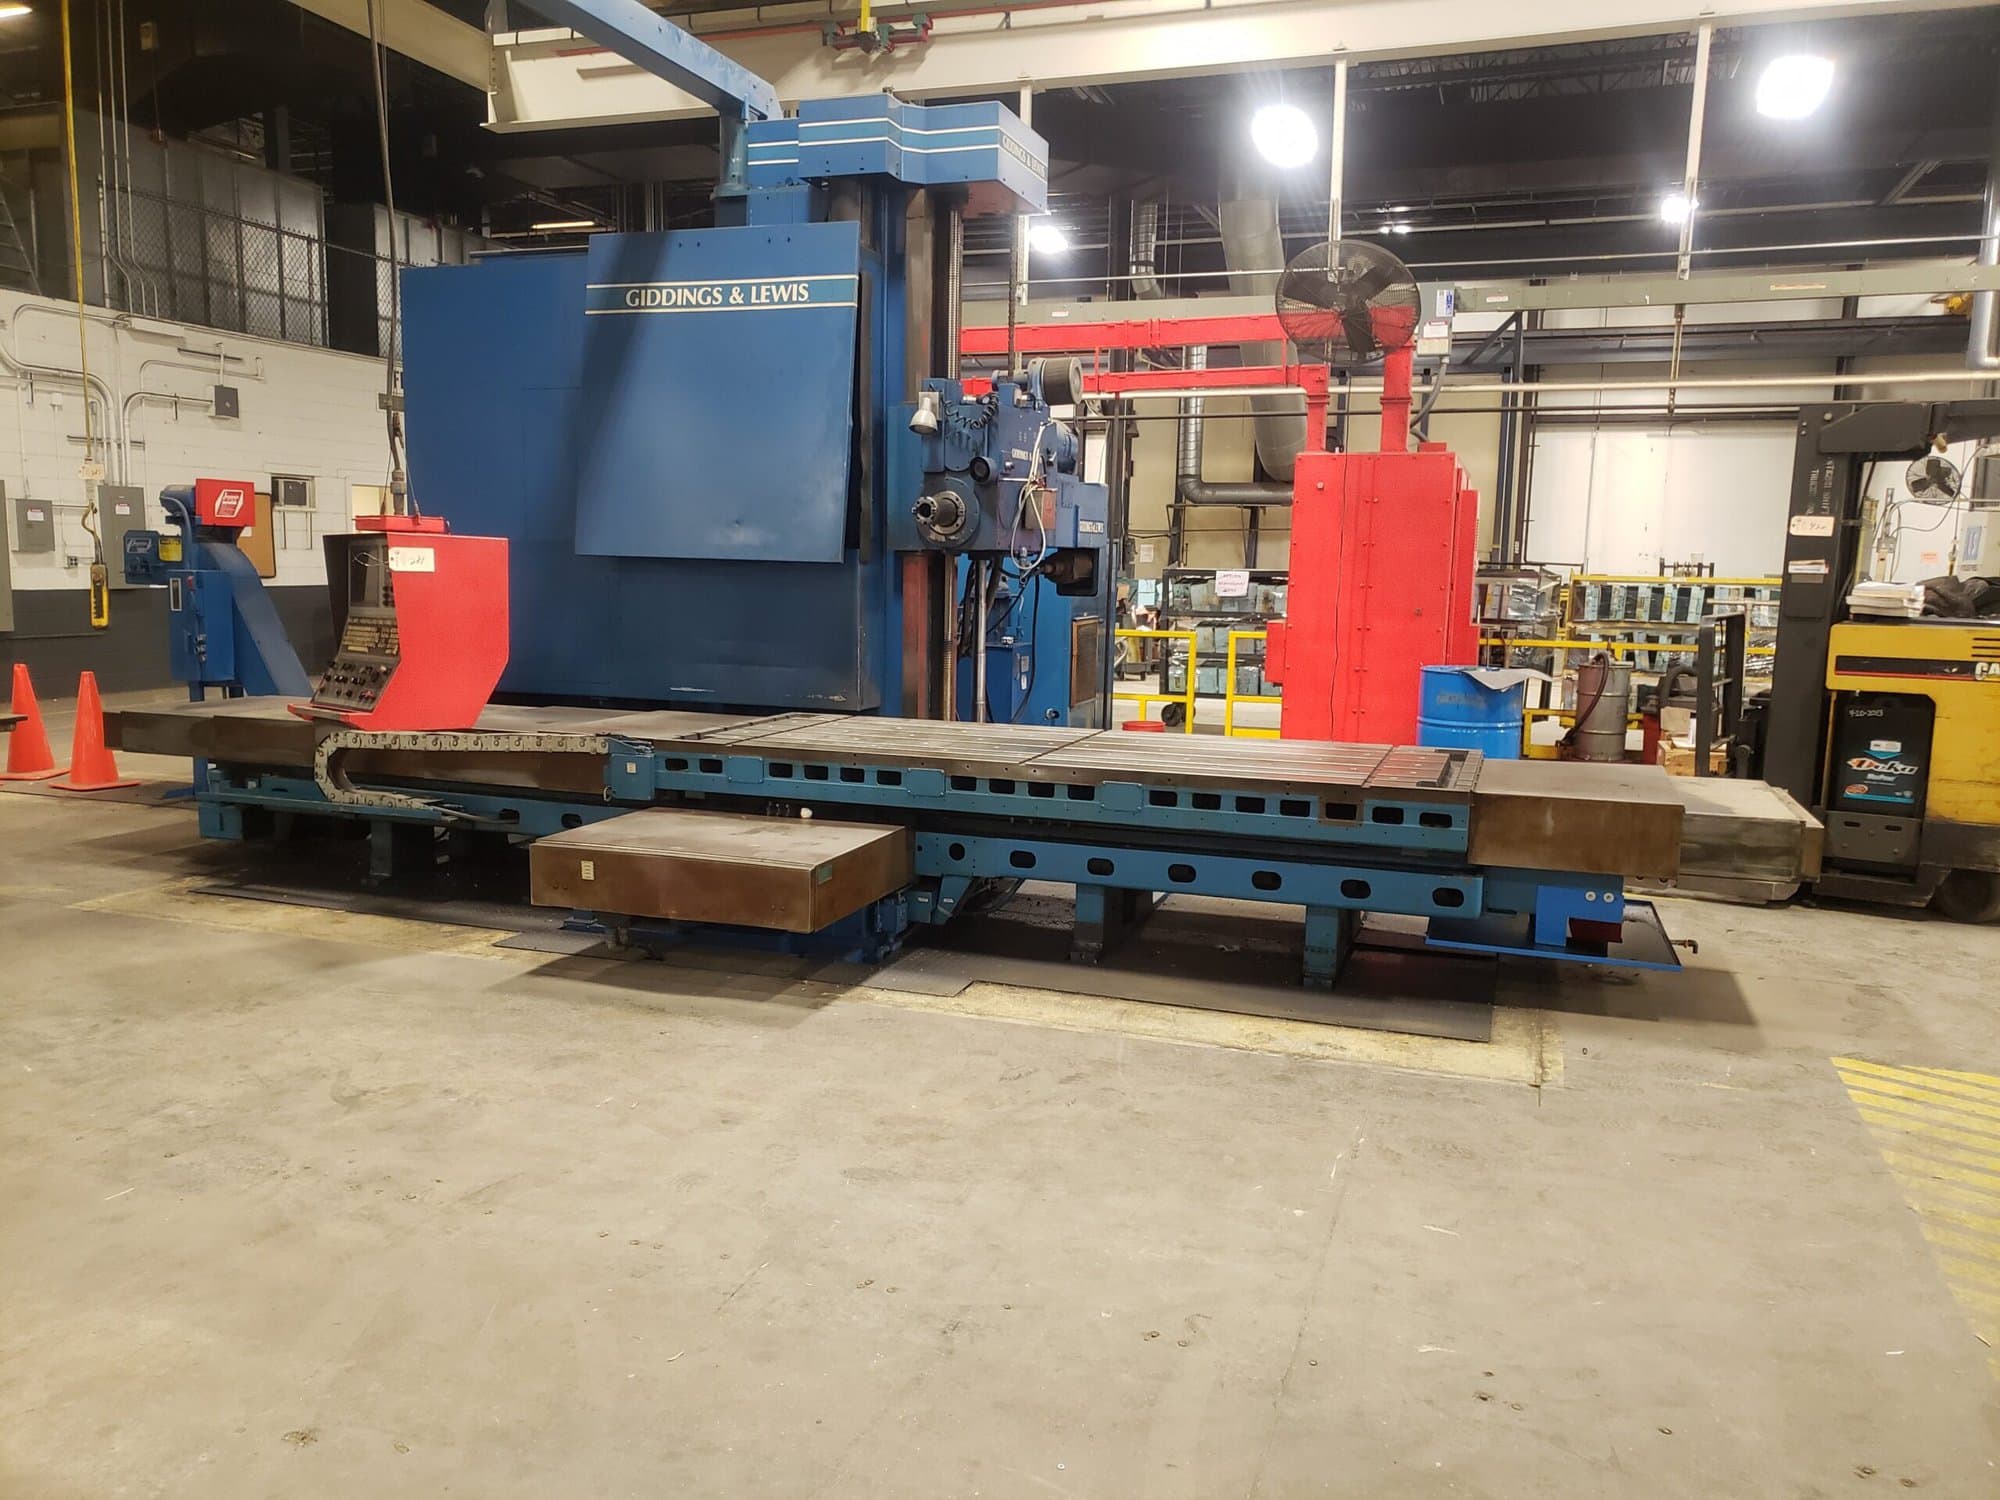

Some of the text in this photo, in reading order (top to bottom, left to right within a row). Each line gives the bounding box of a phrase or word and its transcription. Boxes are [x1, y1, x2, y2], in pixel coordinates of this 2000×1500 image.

[626, 283, 809, 307] GIDDINGS & LEWIS
